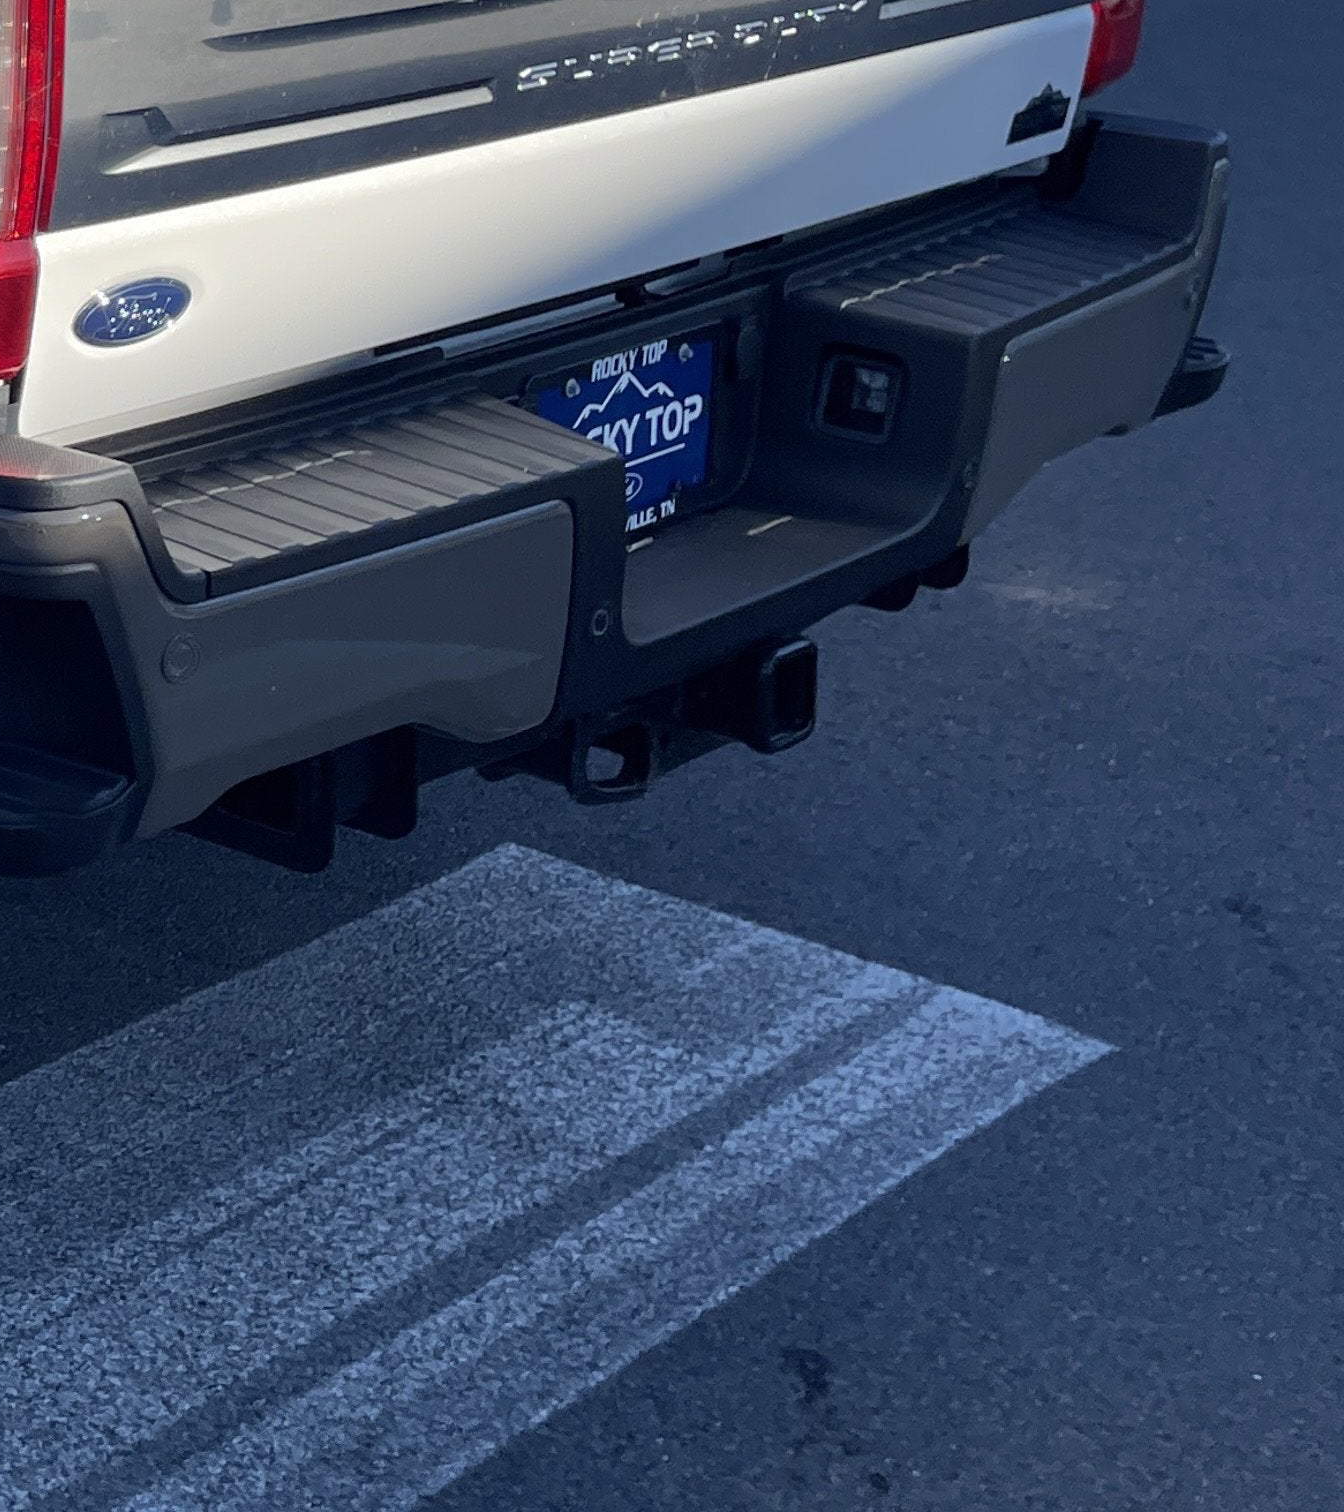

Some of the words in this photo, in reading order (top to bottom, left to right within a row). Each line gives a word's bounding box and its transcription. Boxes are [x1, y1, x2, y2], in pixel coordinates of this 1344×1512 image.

[516, 29, 721, 92] SUPER
[591, 347, 639, 383] ROCKY
[641, 339, 668, 368] TOP
[645, 394, 704, 447] TOP
[660, 498, 676, 519] TN
